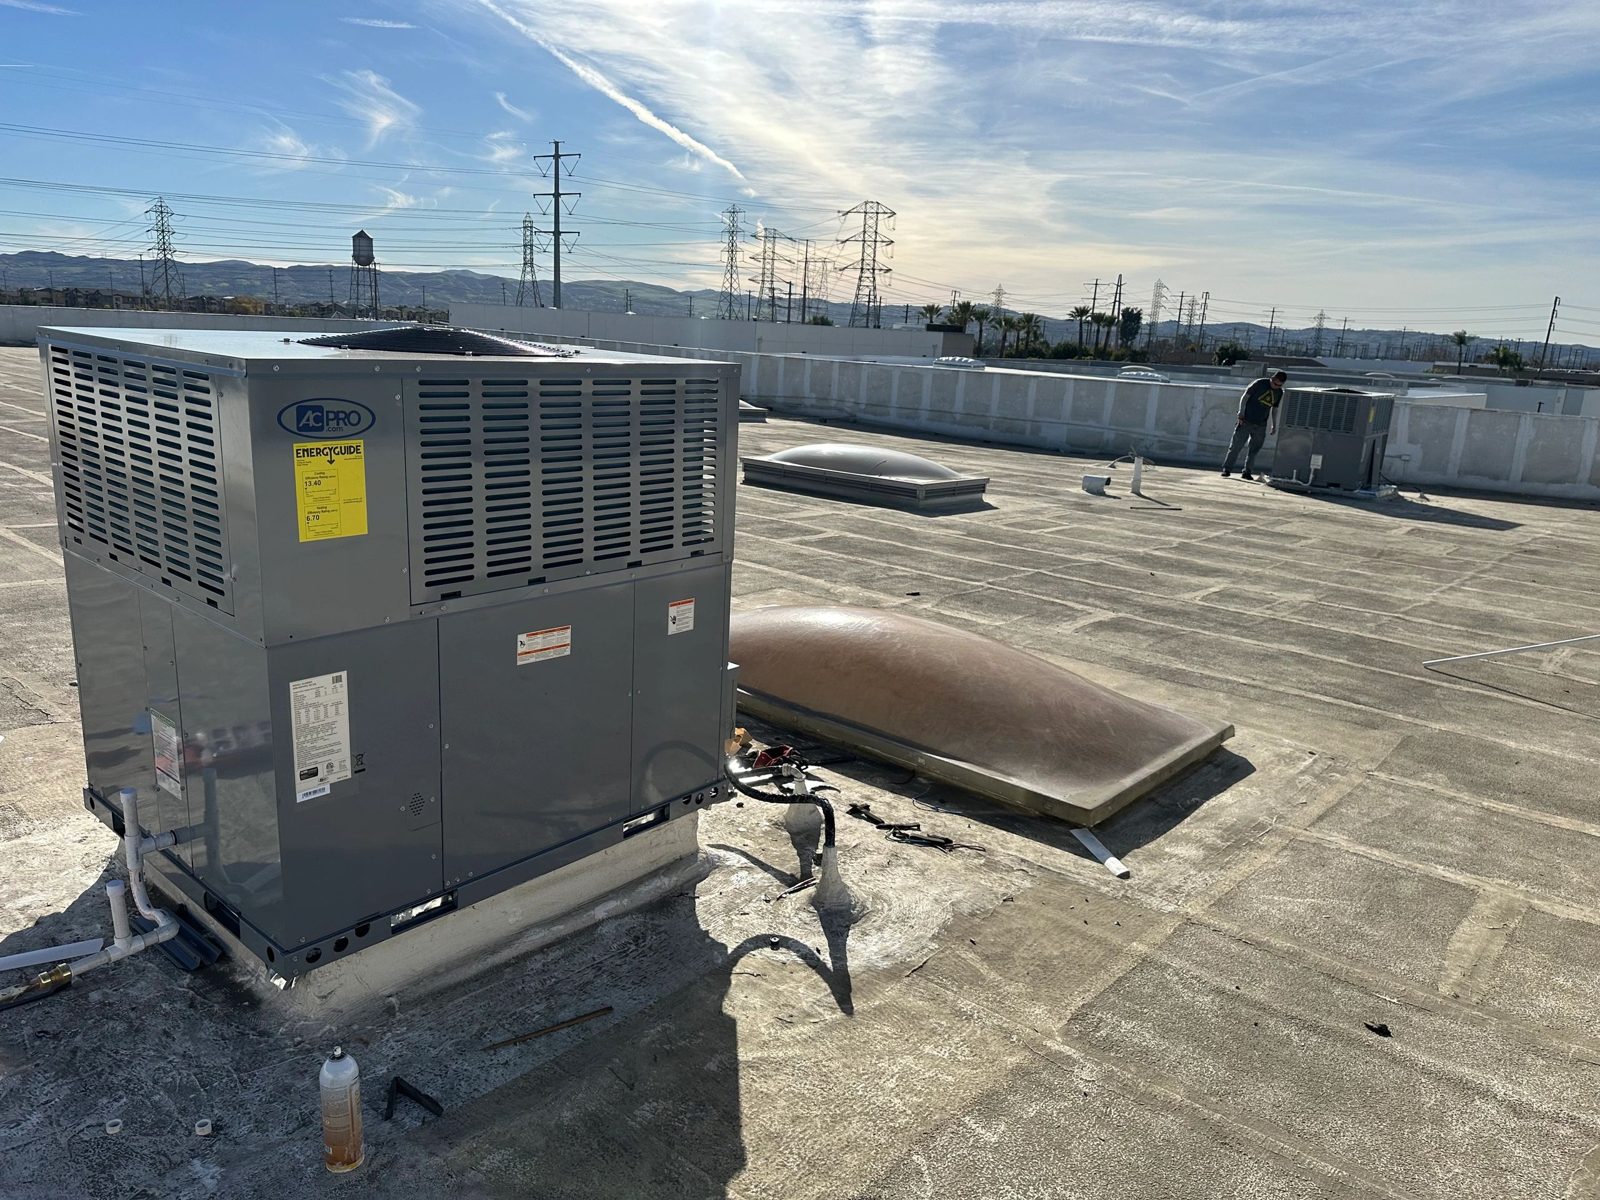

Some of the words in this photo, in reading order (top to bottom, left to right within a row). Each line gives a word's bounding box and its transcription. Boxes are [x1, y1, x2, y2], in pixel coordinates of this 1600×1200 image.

[299, 410, 322, 427] AC
[325, 410, 361, 427] PRO
[296, 445, 361, 458] ENERGYGUIDE
